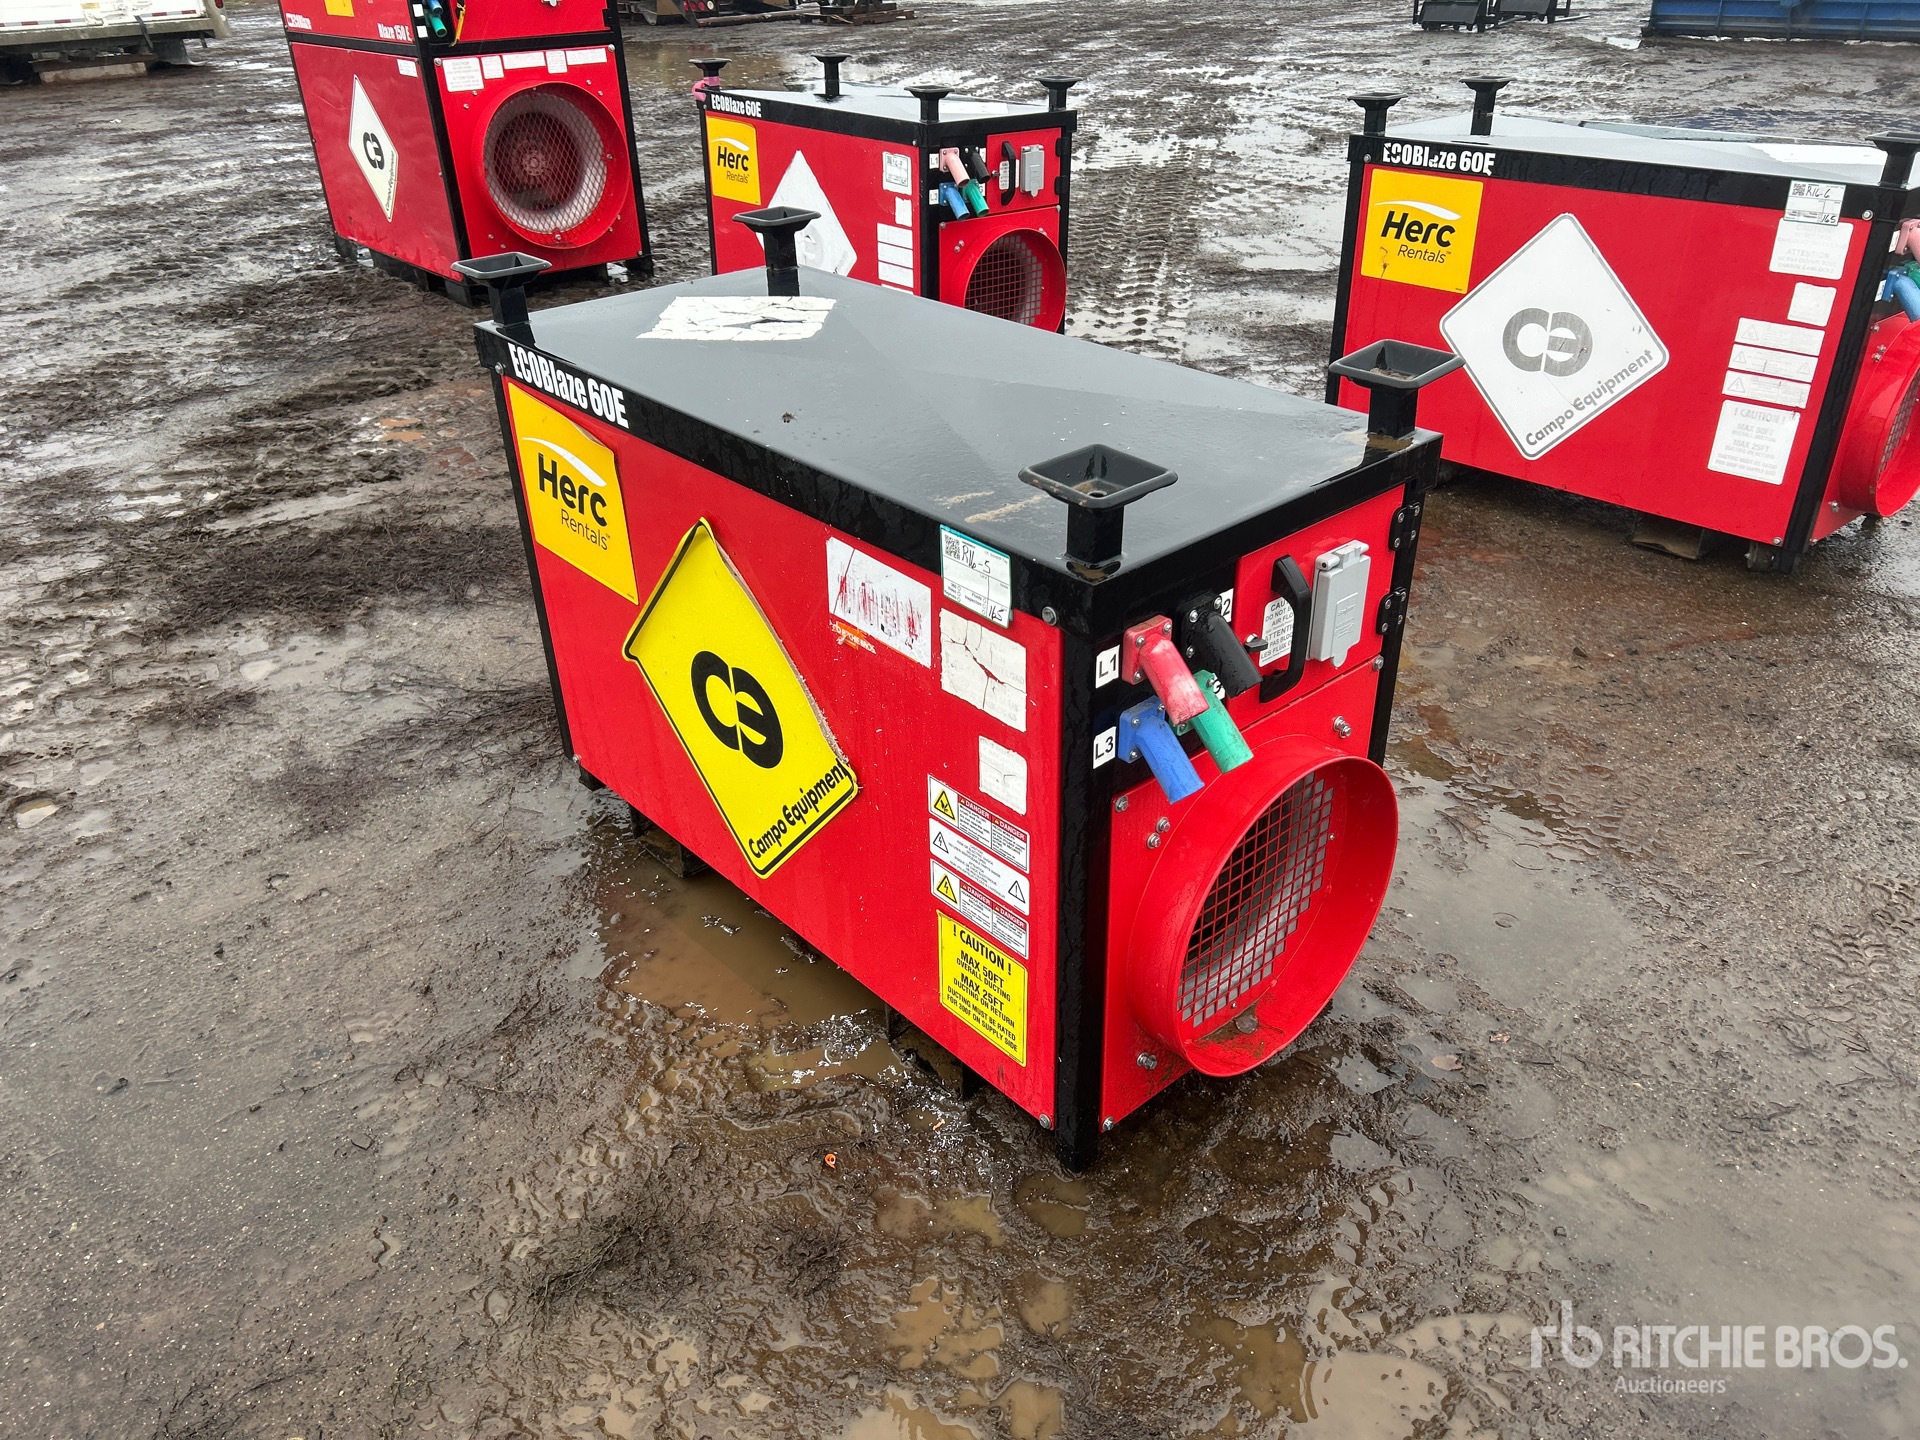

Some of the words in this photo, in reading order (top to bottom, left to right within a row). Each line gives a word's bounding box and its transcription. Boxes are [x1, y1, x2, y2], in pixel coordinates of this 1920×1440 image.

[711, 93, 745, 114] ECOBlaze
[745, 100, 762, 118] 60E
[717, 145, 749, 172] Herc
[1382, 143, 1457, 169] ECOBlaze
[1459, 150, 1496, 176] 60E
[1380, 210, 1456, 248] Herc
[1397, 244, 1448, 264] Rentals
[508, 342, 589, 410] ECOBlaze
[587, 378, 629, 429] 60E
[1526, 409, 1575, 446] Campo
[1739, 408, 1779, 423] CAUTION
[538, 452, 608, 527] Herc
[561, 508, 609, 551] Rentals
[1265, 613, 1274, 623] DO
[1274, 608, 1287, 618] NOT
[1270, 599, 1289, 612] CAU
[1265, 623, 1294, 642] ATTENTI
[1271, 617, 1282, 627] AIR
[1098, 653, 1117, 678] L1
[1095, 736, 1114, 760] L3
[965, 799, 989, 819] DANGER
[748, 819, 788, 859] Campo
[999, 820, 1024, 840] DANGER
[967, 885, 990, 905] DANGER
[1000, 907, 1023, 927] DANGER
[953, 923, 956, 937] !
[959, 928, 1004, 970] CAUTION
[1007, 961, 1011, 976] !
[956, 957, 982, 982] OVERALL
[983, 976, 1010, 1002] DUCTING
[960, 949, 980, 972] MAX
[982, 965, 1004, 989] 50FT
[953, 977, 978, 1001] DUCTING
[980, 997, 988, 1009] ON
[990, 1004, 1014, 1028] RETURN
[961, 972, 980, 994] MAX
[982, 988, 1003, 1012] 25FT
[947, 984, 970, 1007] DUCTING
[971, 1003, 987, 1020] MUST
[989, 1016, 996, 1027] BE
[997, 1022, 1015, 1041] RATED
[947, 993, 957, 1006] FOR
[972, 1012, 980, 1024] ON
[982, 1019, 1002, 1041] SUPPLY
